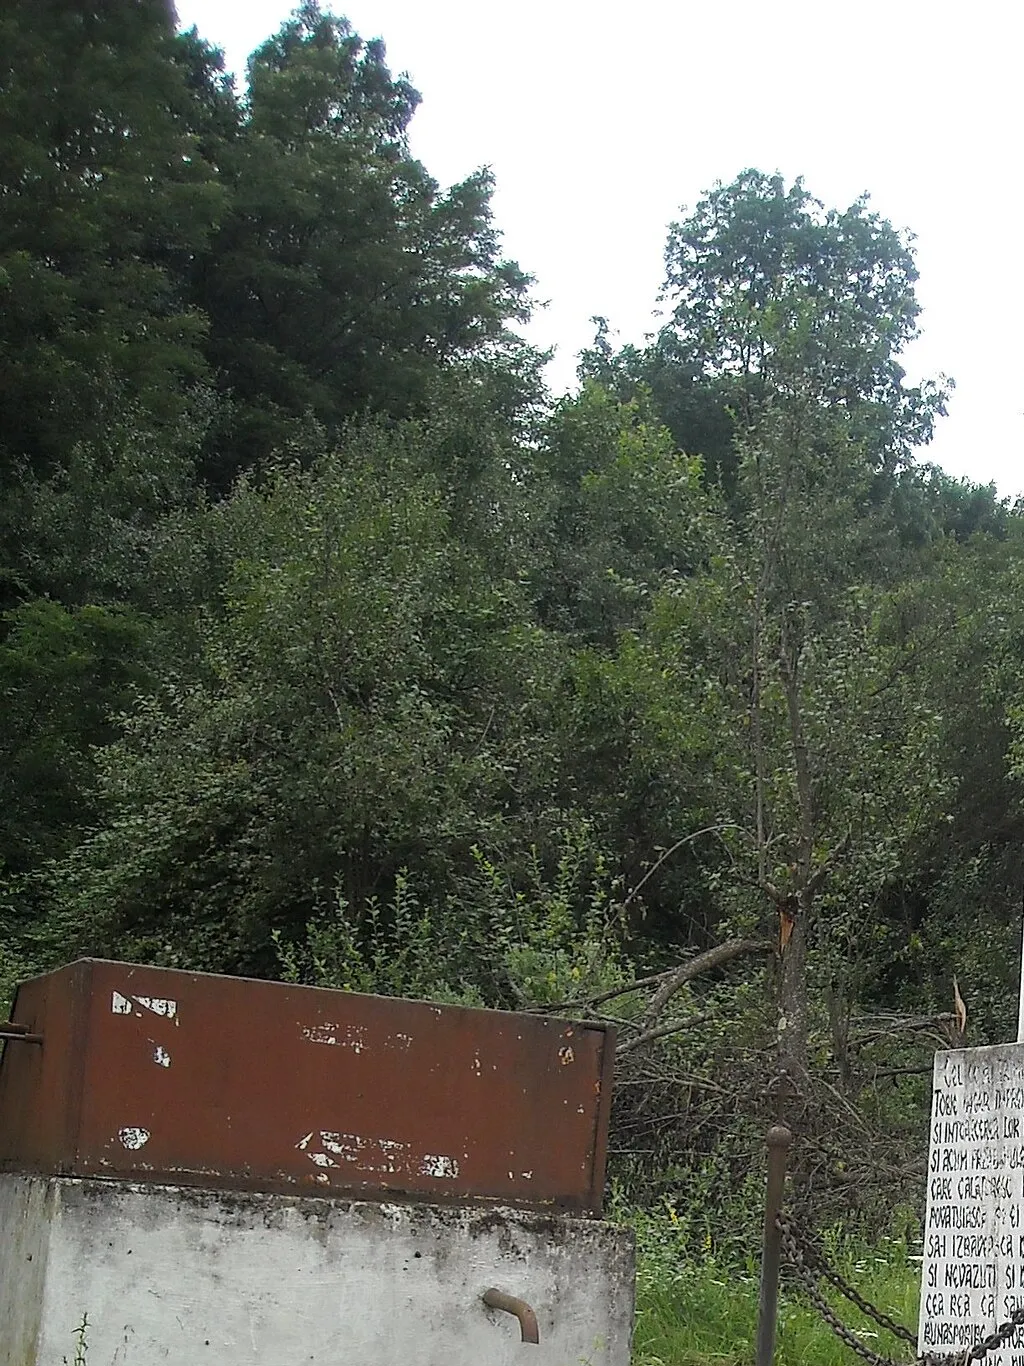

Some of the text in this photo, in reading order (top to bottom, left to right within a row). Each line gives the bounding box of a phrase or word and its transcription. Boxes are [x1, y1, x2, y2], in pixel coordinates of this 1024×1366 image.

[928, 1264, 937, 1287] SI
[1006, 1264, 1015, 1289] SI
[981, 1294, 994, 1318] CA
